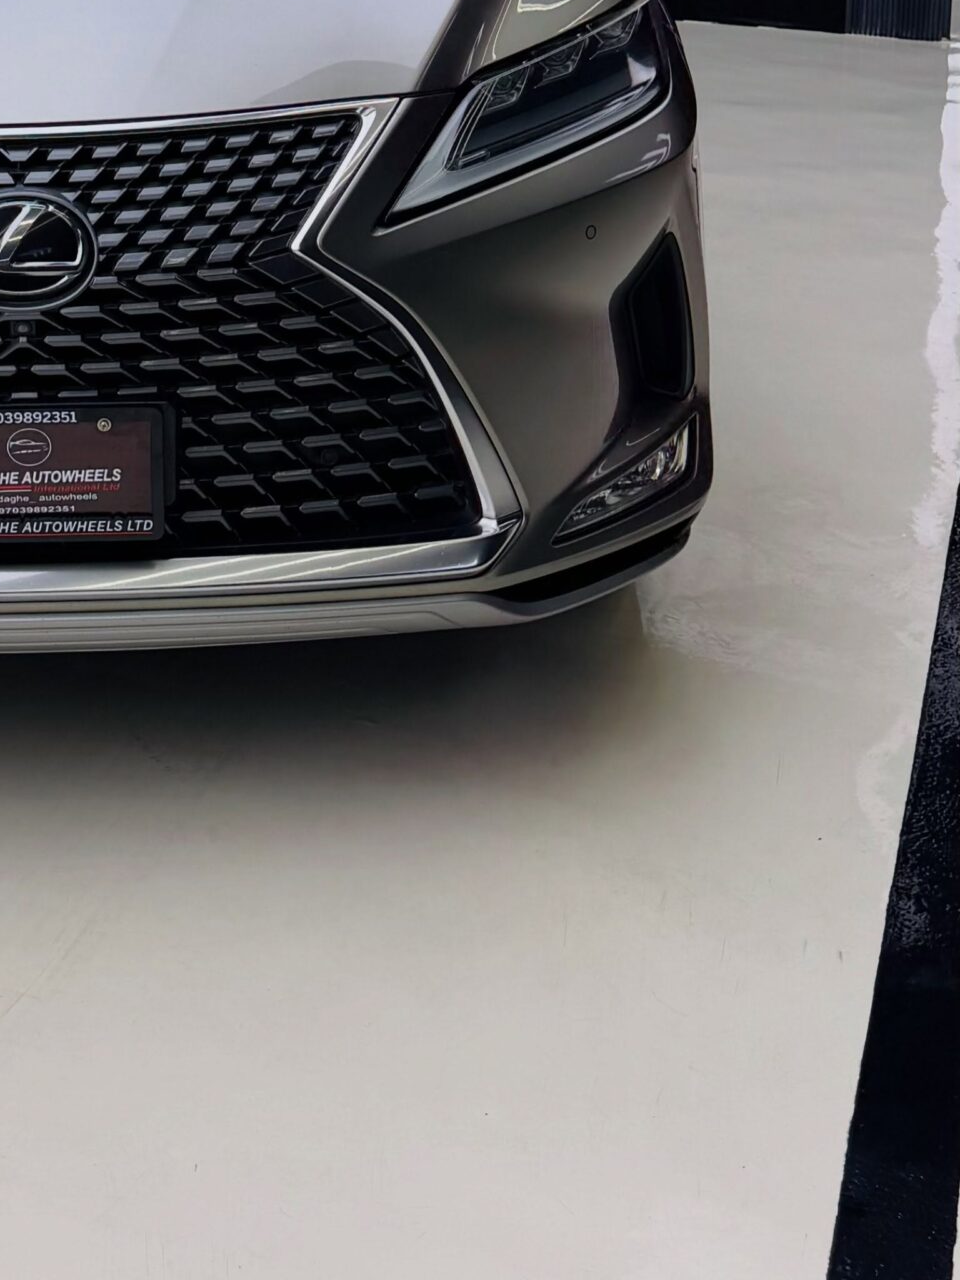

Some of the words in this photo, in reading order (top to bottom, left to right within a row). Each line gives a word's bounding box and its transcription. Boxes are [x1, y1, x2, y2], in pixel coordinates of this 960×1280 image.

[21, 468, 122, 485] AUTOWHEELS
[21, 519, 123, 534] AUTOWHEELS
[126, 519, 154, 532] LTD
